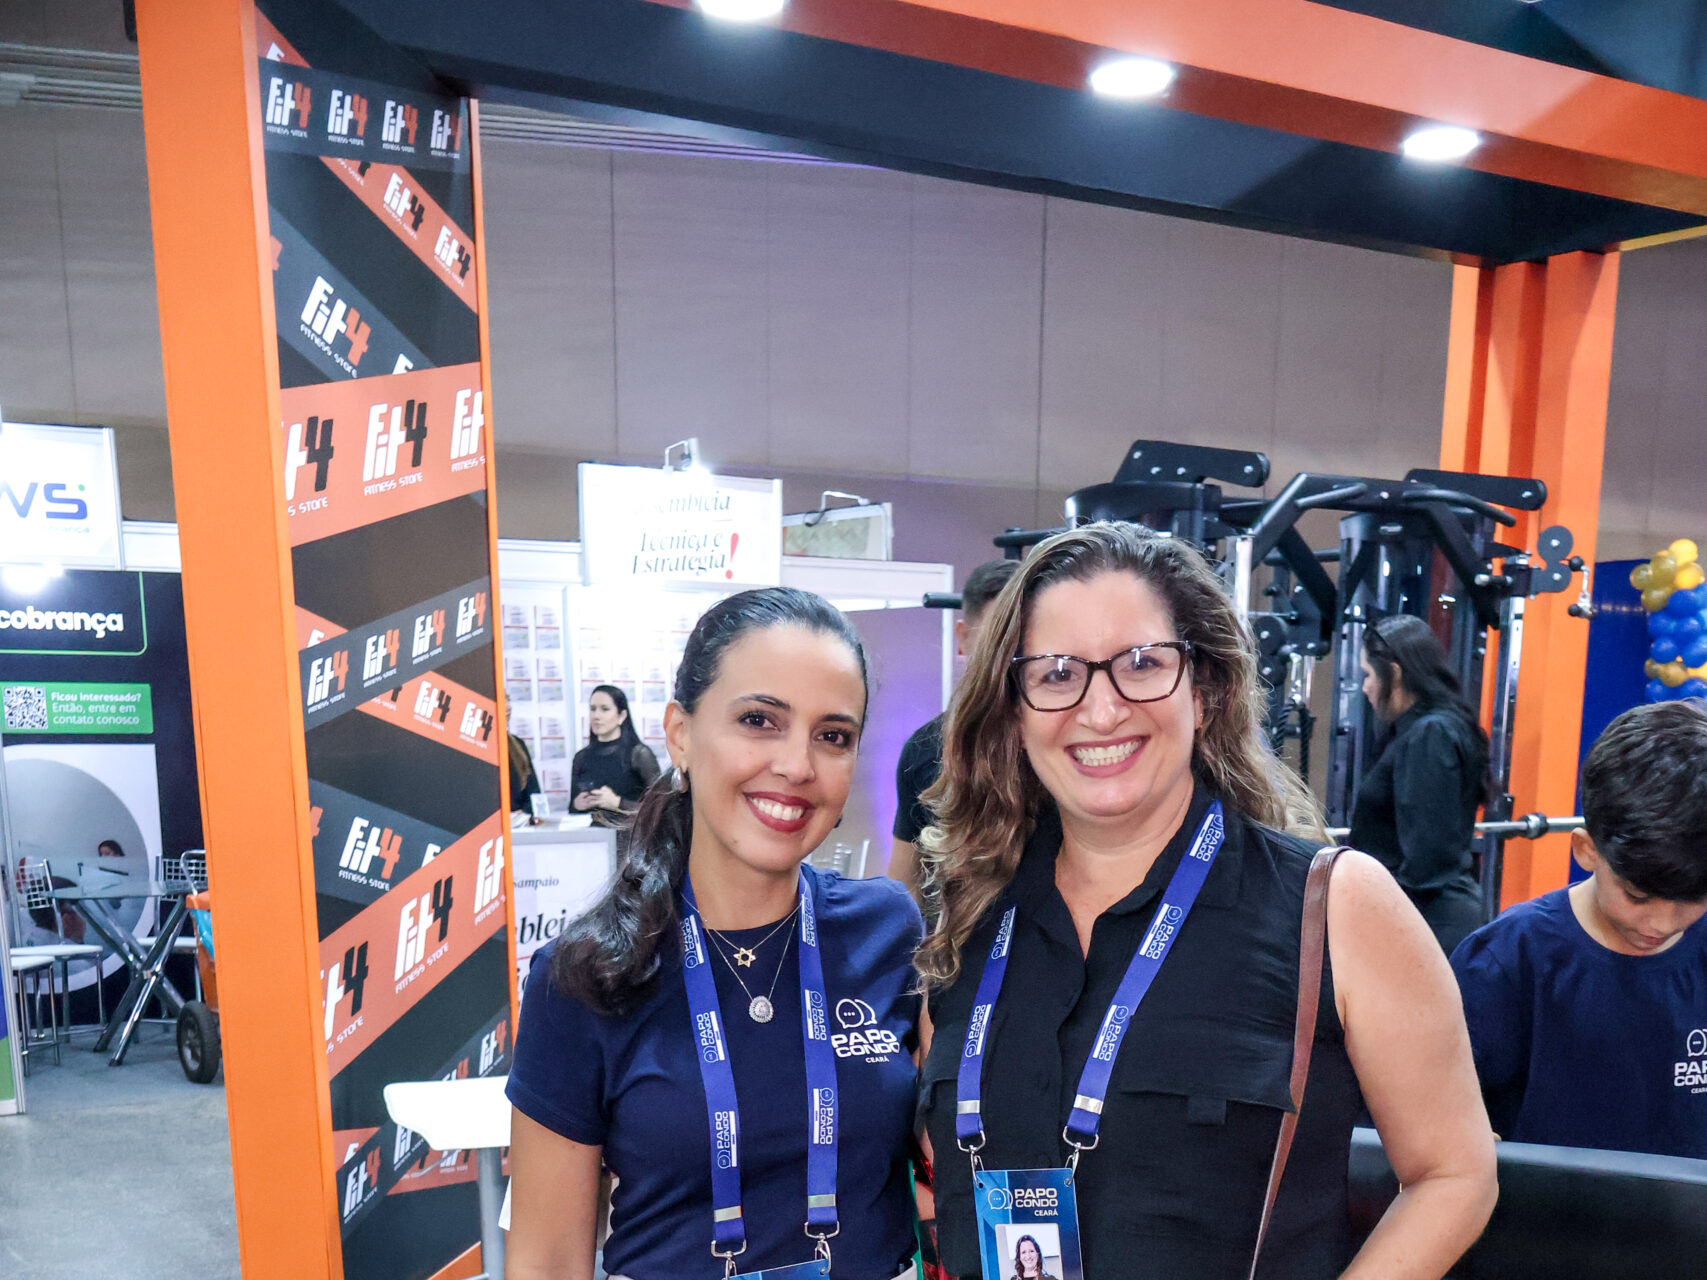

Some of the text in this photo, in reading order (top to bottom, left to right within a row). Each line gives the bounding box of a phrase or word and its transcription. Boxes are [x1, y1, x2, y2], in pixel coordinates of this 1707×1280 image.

[266, 76, 312, 129] Fit4
[327, 88, 368, 137] Fit4
[381, 99, 418, 145] Fit4
[384, 172, 425, 232] Fit4
[434, 224, 470, 279] Fit4
[301, 275, 371, 366] Fit4
[362, 399, 427, 482] Fit4
[364, 472, 423, 496] FITNESS STORE
[298, 497, 328, 513] STORE
[412, 608, 446, 658] Fit4
[456, 591, 486, 638] Fit4
[362, 628, 400, 681] Fit4
[51, 692, 78, 702] Ficou
[307, 650, 349, 707] Fit4
[119, 704, 136, 713] em
[414, 679, 451, 723] Fit4
[459, 701, 494, 741] Fit4
[338, 816, 402, 880] Fit4
[1202, 830, 1222, 862] PAPO
[394, 875, 453, 982] Fit4
[1151, 925, 1175, 960] PAPO
[696, 1013, 710, 1046] PAPO
[818, 1009, 827, 1041] PAPO
[830, 1029, 897, 1049] PAPO
[968, 1005, 982, 1039] PAPO
[835, 1042, 900, 1058] CONDO
[865, 1055, 890, 1063] CEARÁ
[1104, 1025, 1122, 1062] PAPO
[1674, 1075, 1707, 1087] CON
[714, 1111, 725, 1150] PAPO
[722, 1111, 731, 1149] CONDO
[1014, 1187, 1058, 1199] PAPO
[1015, 1198, 1058, 1208] CONDO
[1034, 1209, 1059, 1217] CEARÁ
